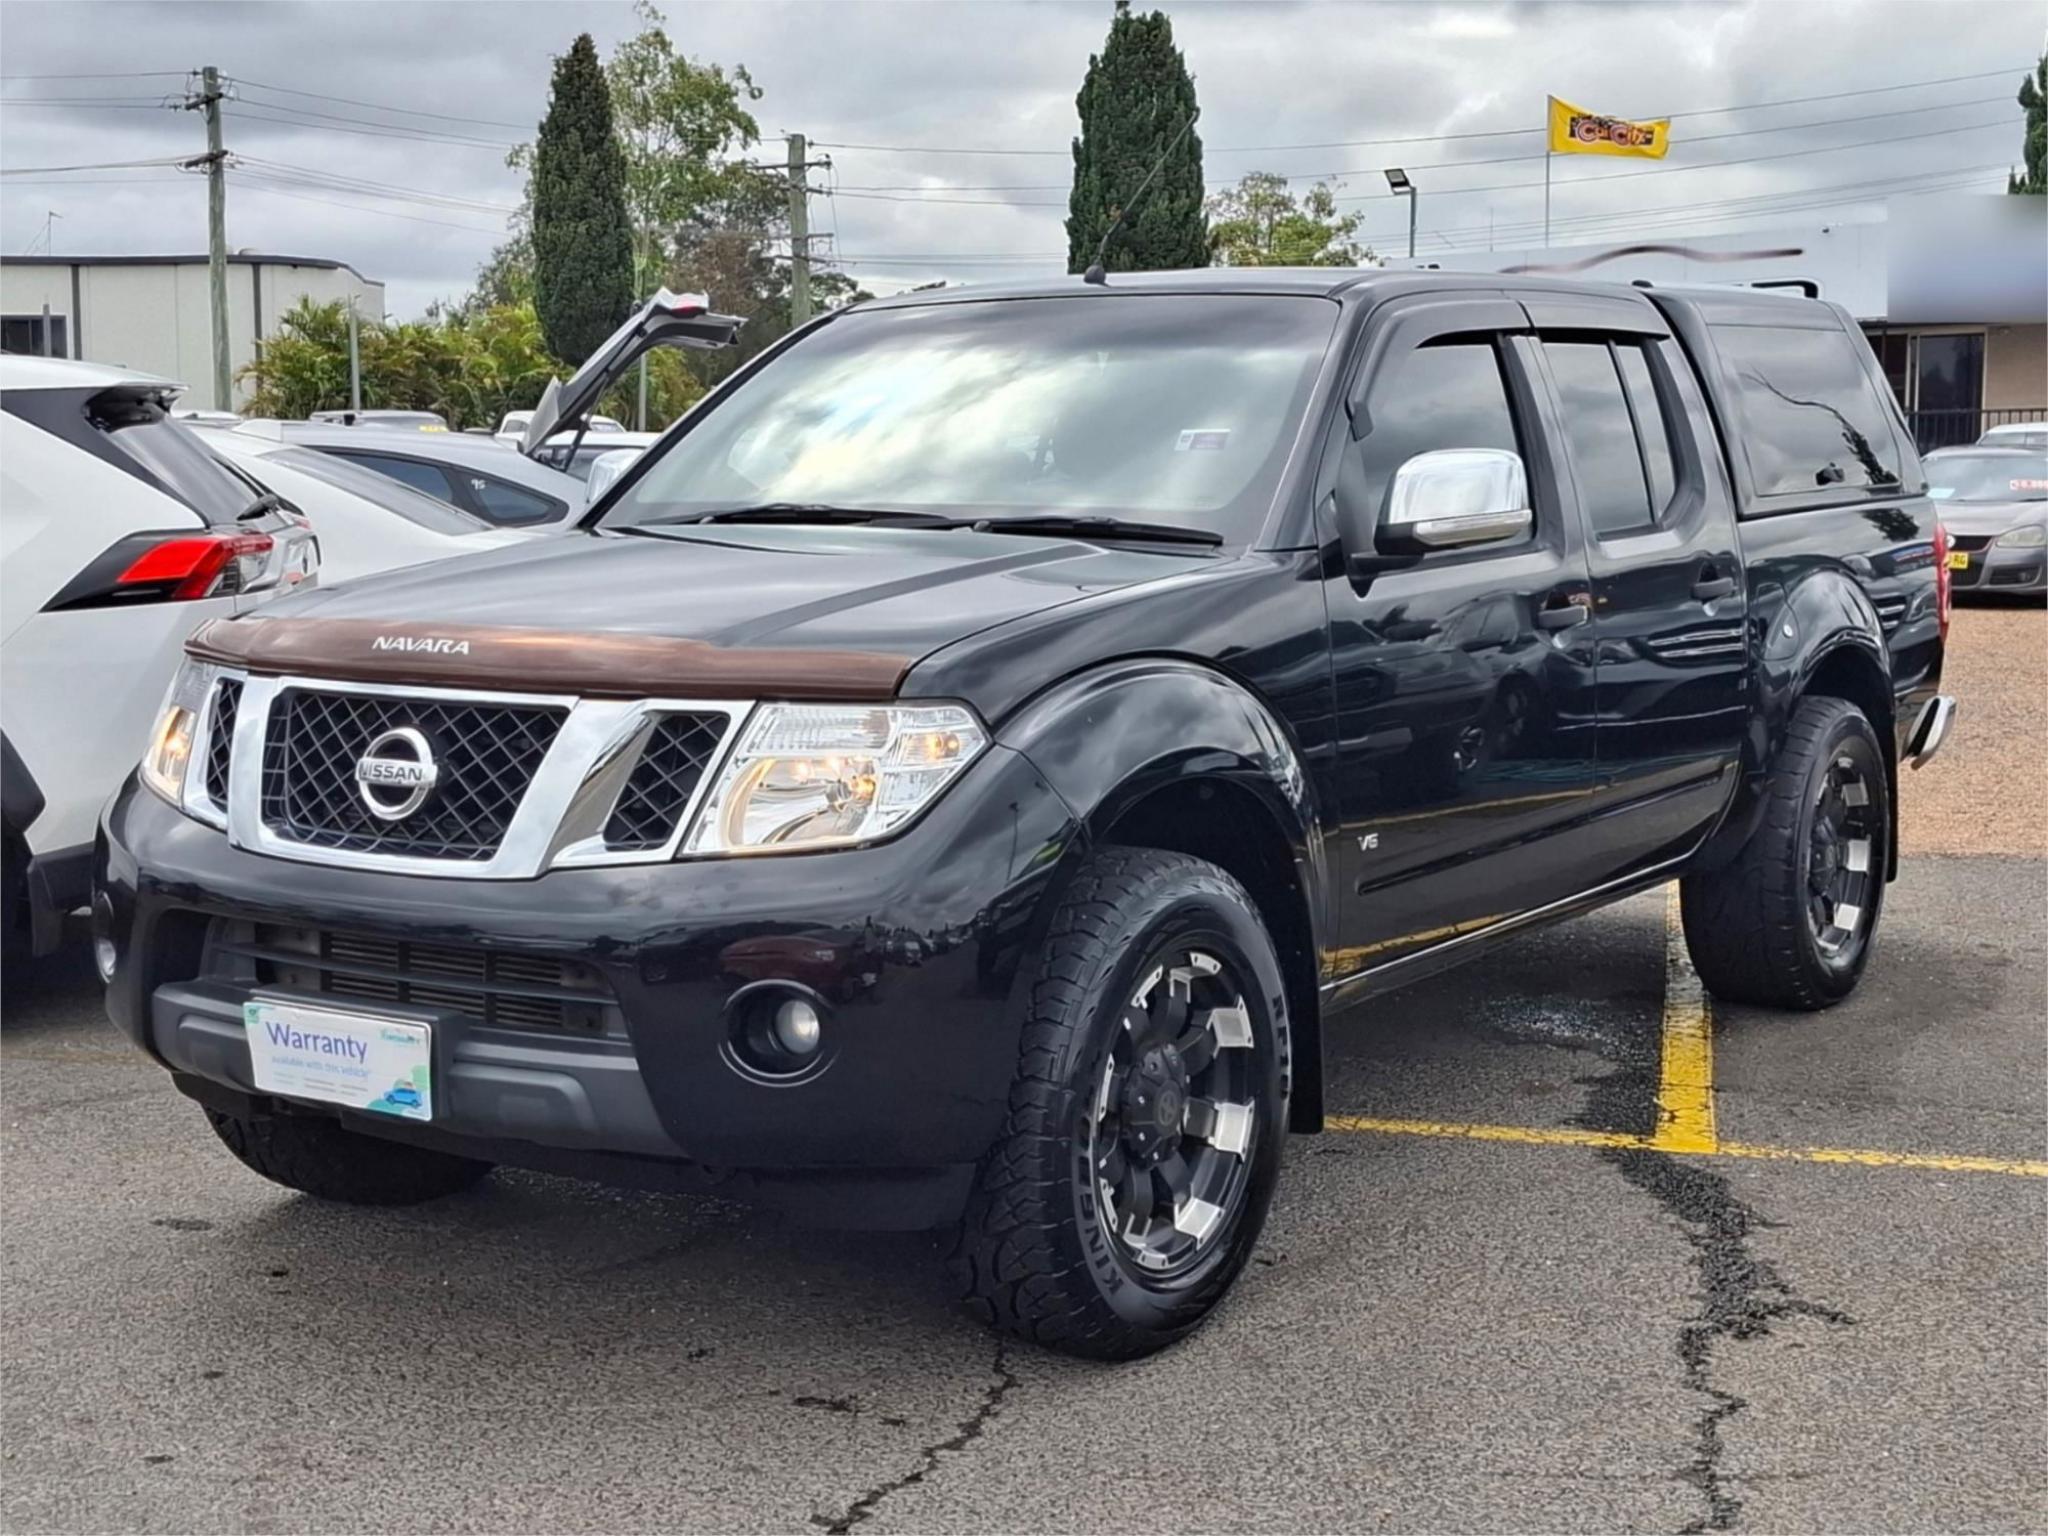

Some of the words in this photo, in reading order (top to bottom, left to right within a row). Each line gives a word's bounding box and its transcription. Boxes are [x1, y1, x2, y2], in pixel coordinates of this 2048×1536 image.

[371, 636, 470, 655] NAVARA
[359, 761, 423, 782] NISSAN
[1357, 833, 1379, 851] V6
[265, 1020, 368, 1064] Warranty
